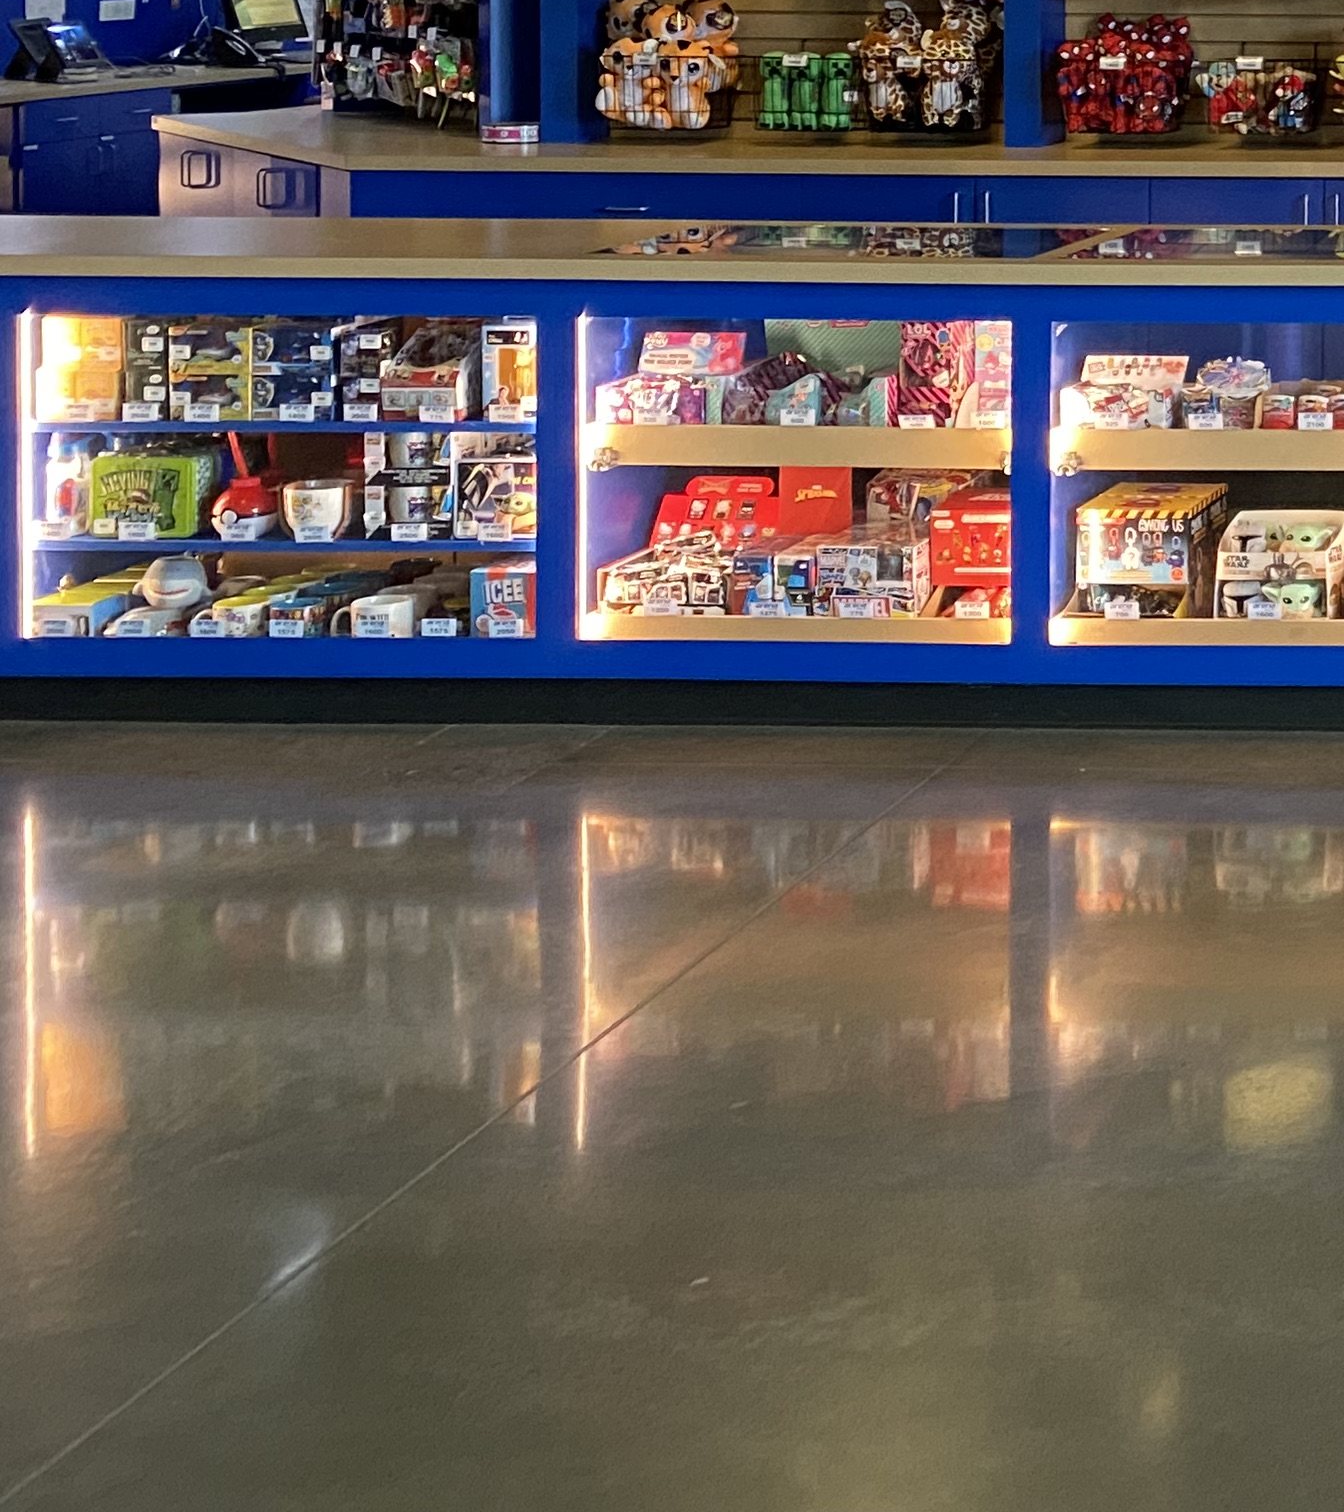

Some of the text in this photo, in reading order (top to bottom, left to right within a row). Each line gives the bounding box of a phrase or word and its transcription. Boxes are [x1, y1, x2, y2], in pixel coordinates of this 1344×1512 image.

[1138, 519, 1185, 533] AMONG US
[483, 577, 525, 605] ICEE
